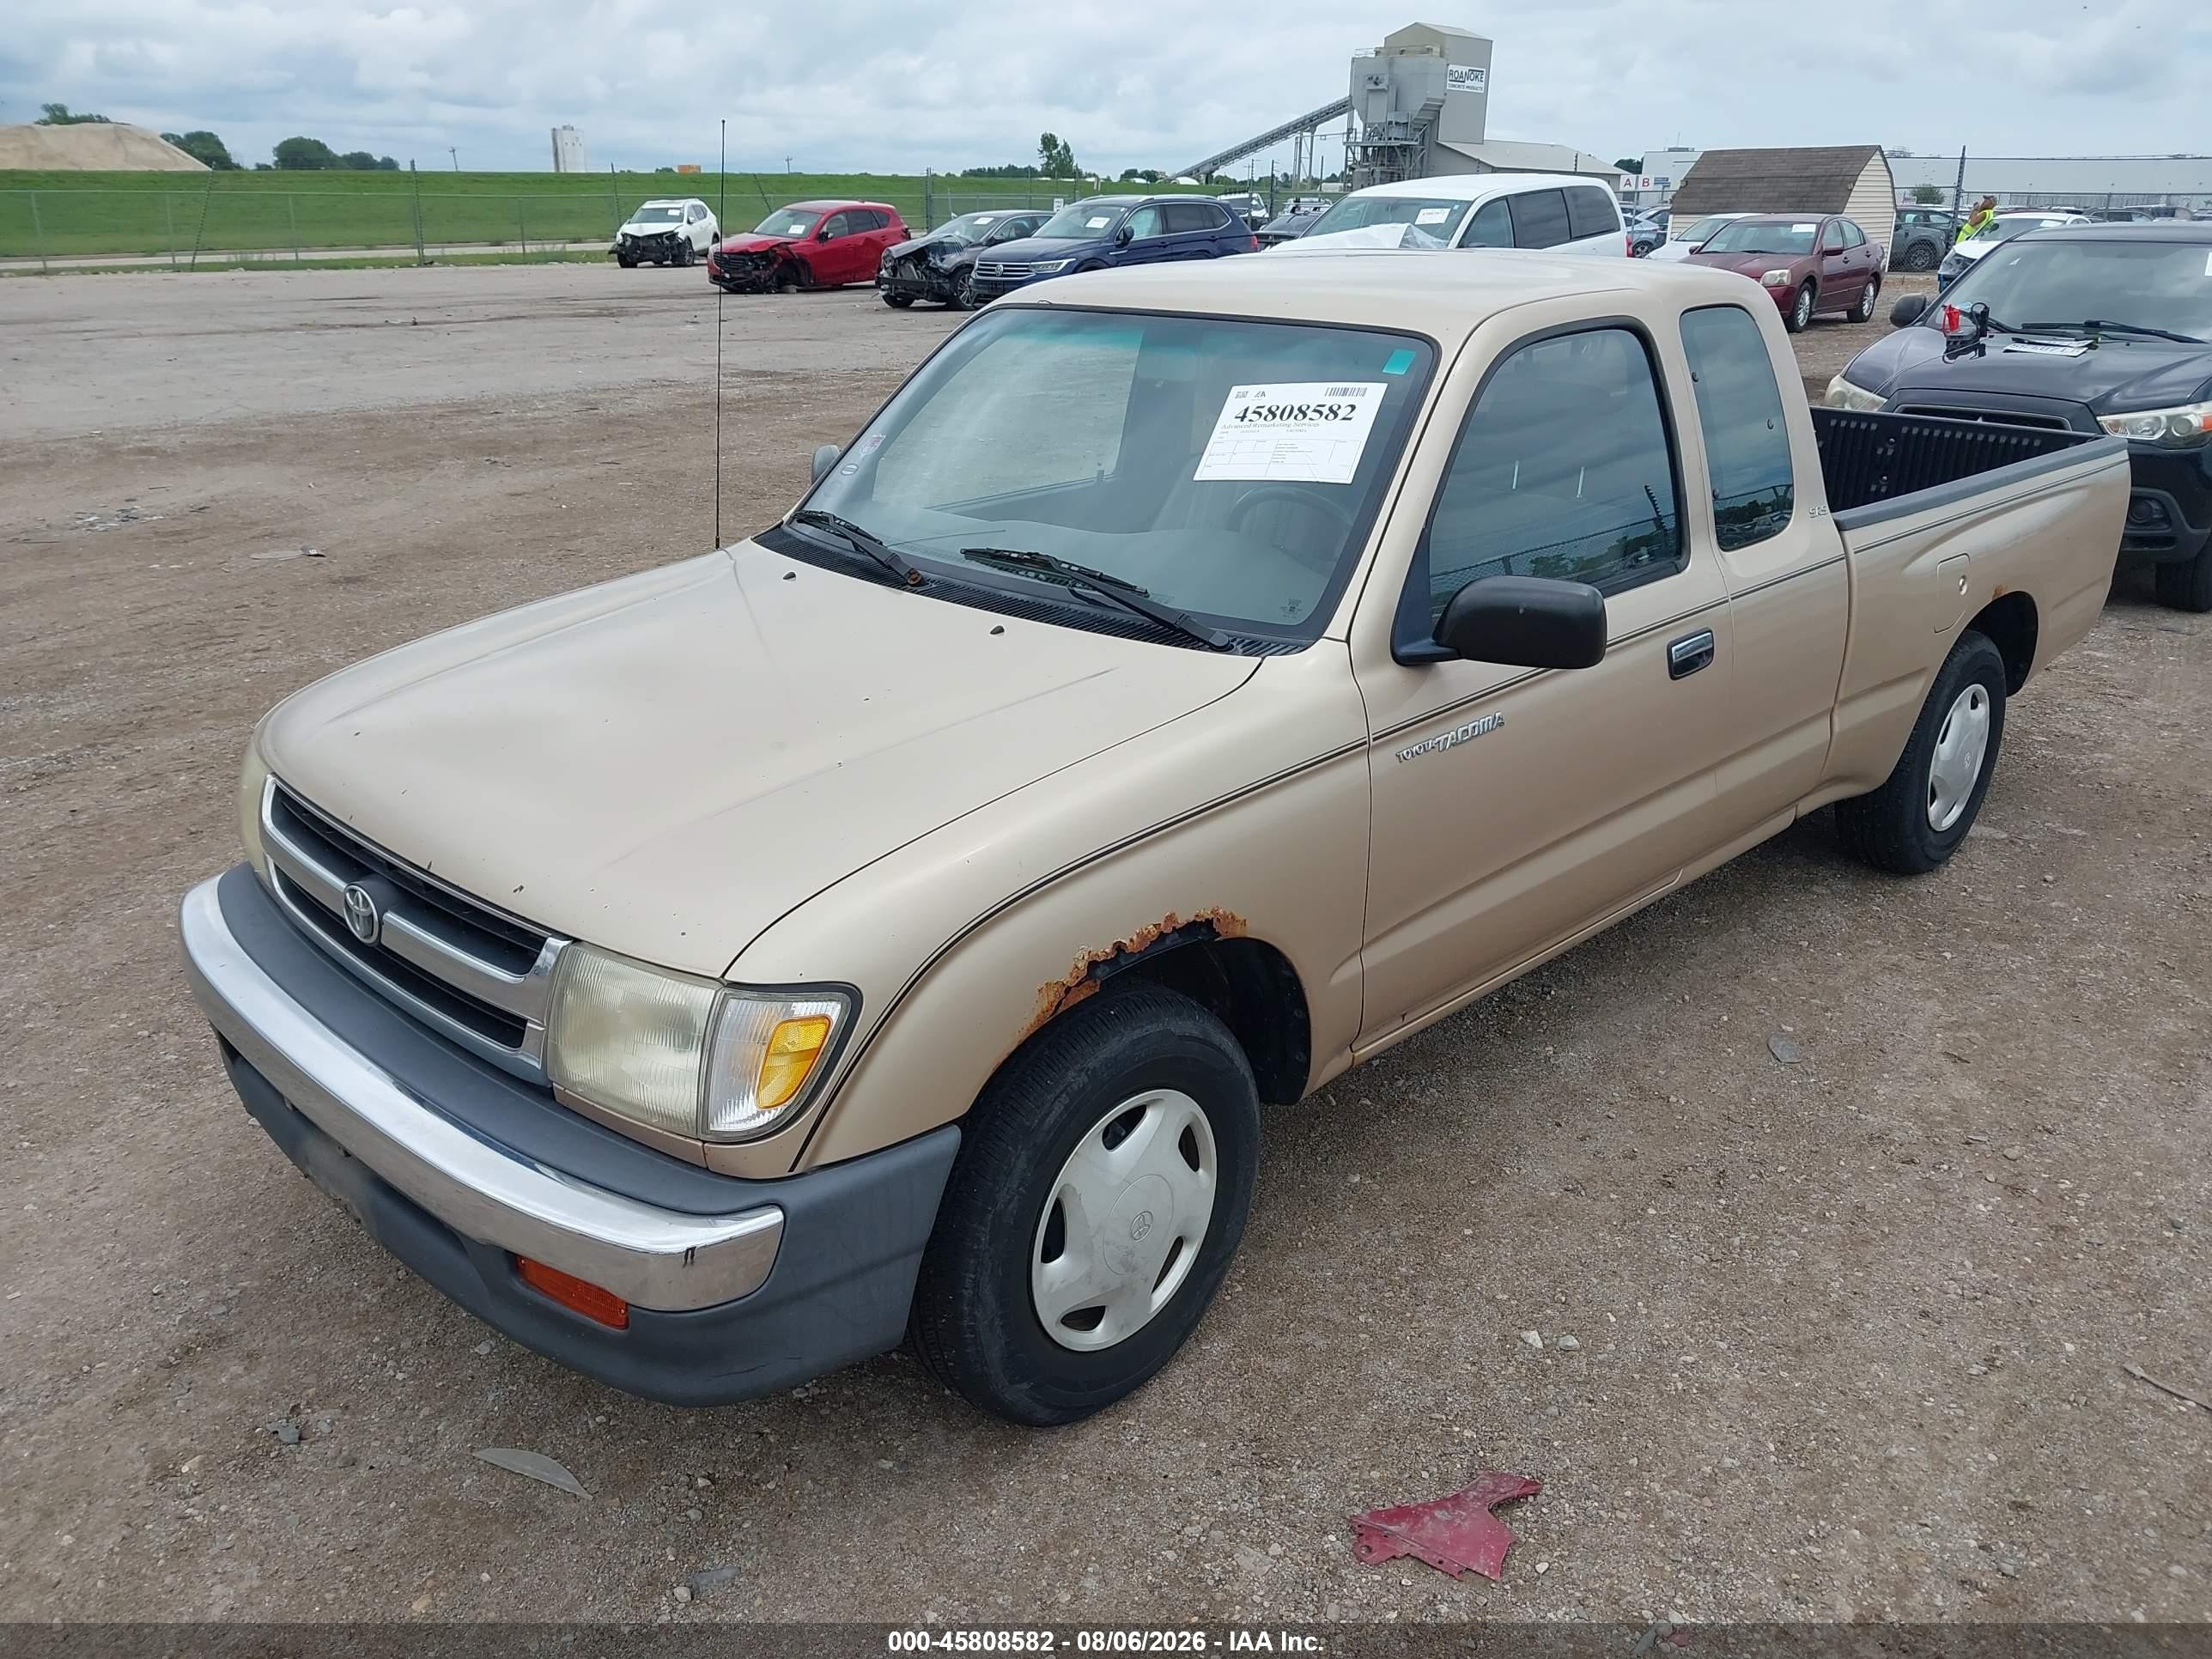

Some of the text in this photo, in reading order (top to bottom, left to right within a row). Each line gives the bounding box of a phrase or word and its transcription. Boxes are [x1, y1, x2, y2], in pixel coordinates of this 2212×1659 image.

[1448, 69, 1484, 82] ROANOKE
[1623, 177, 1632, 187] A
[1641, 177, 1650, 187] B
[1234, 404, 1357, 422] 45808582
[1395, 711, 1504, 763] TOYOTA TACOMA
